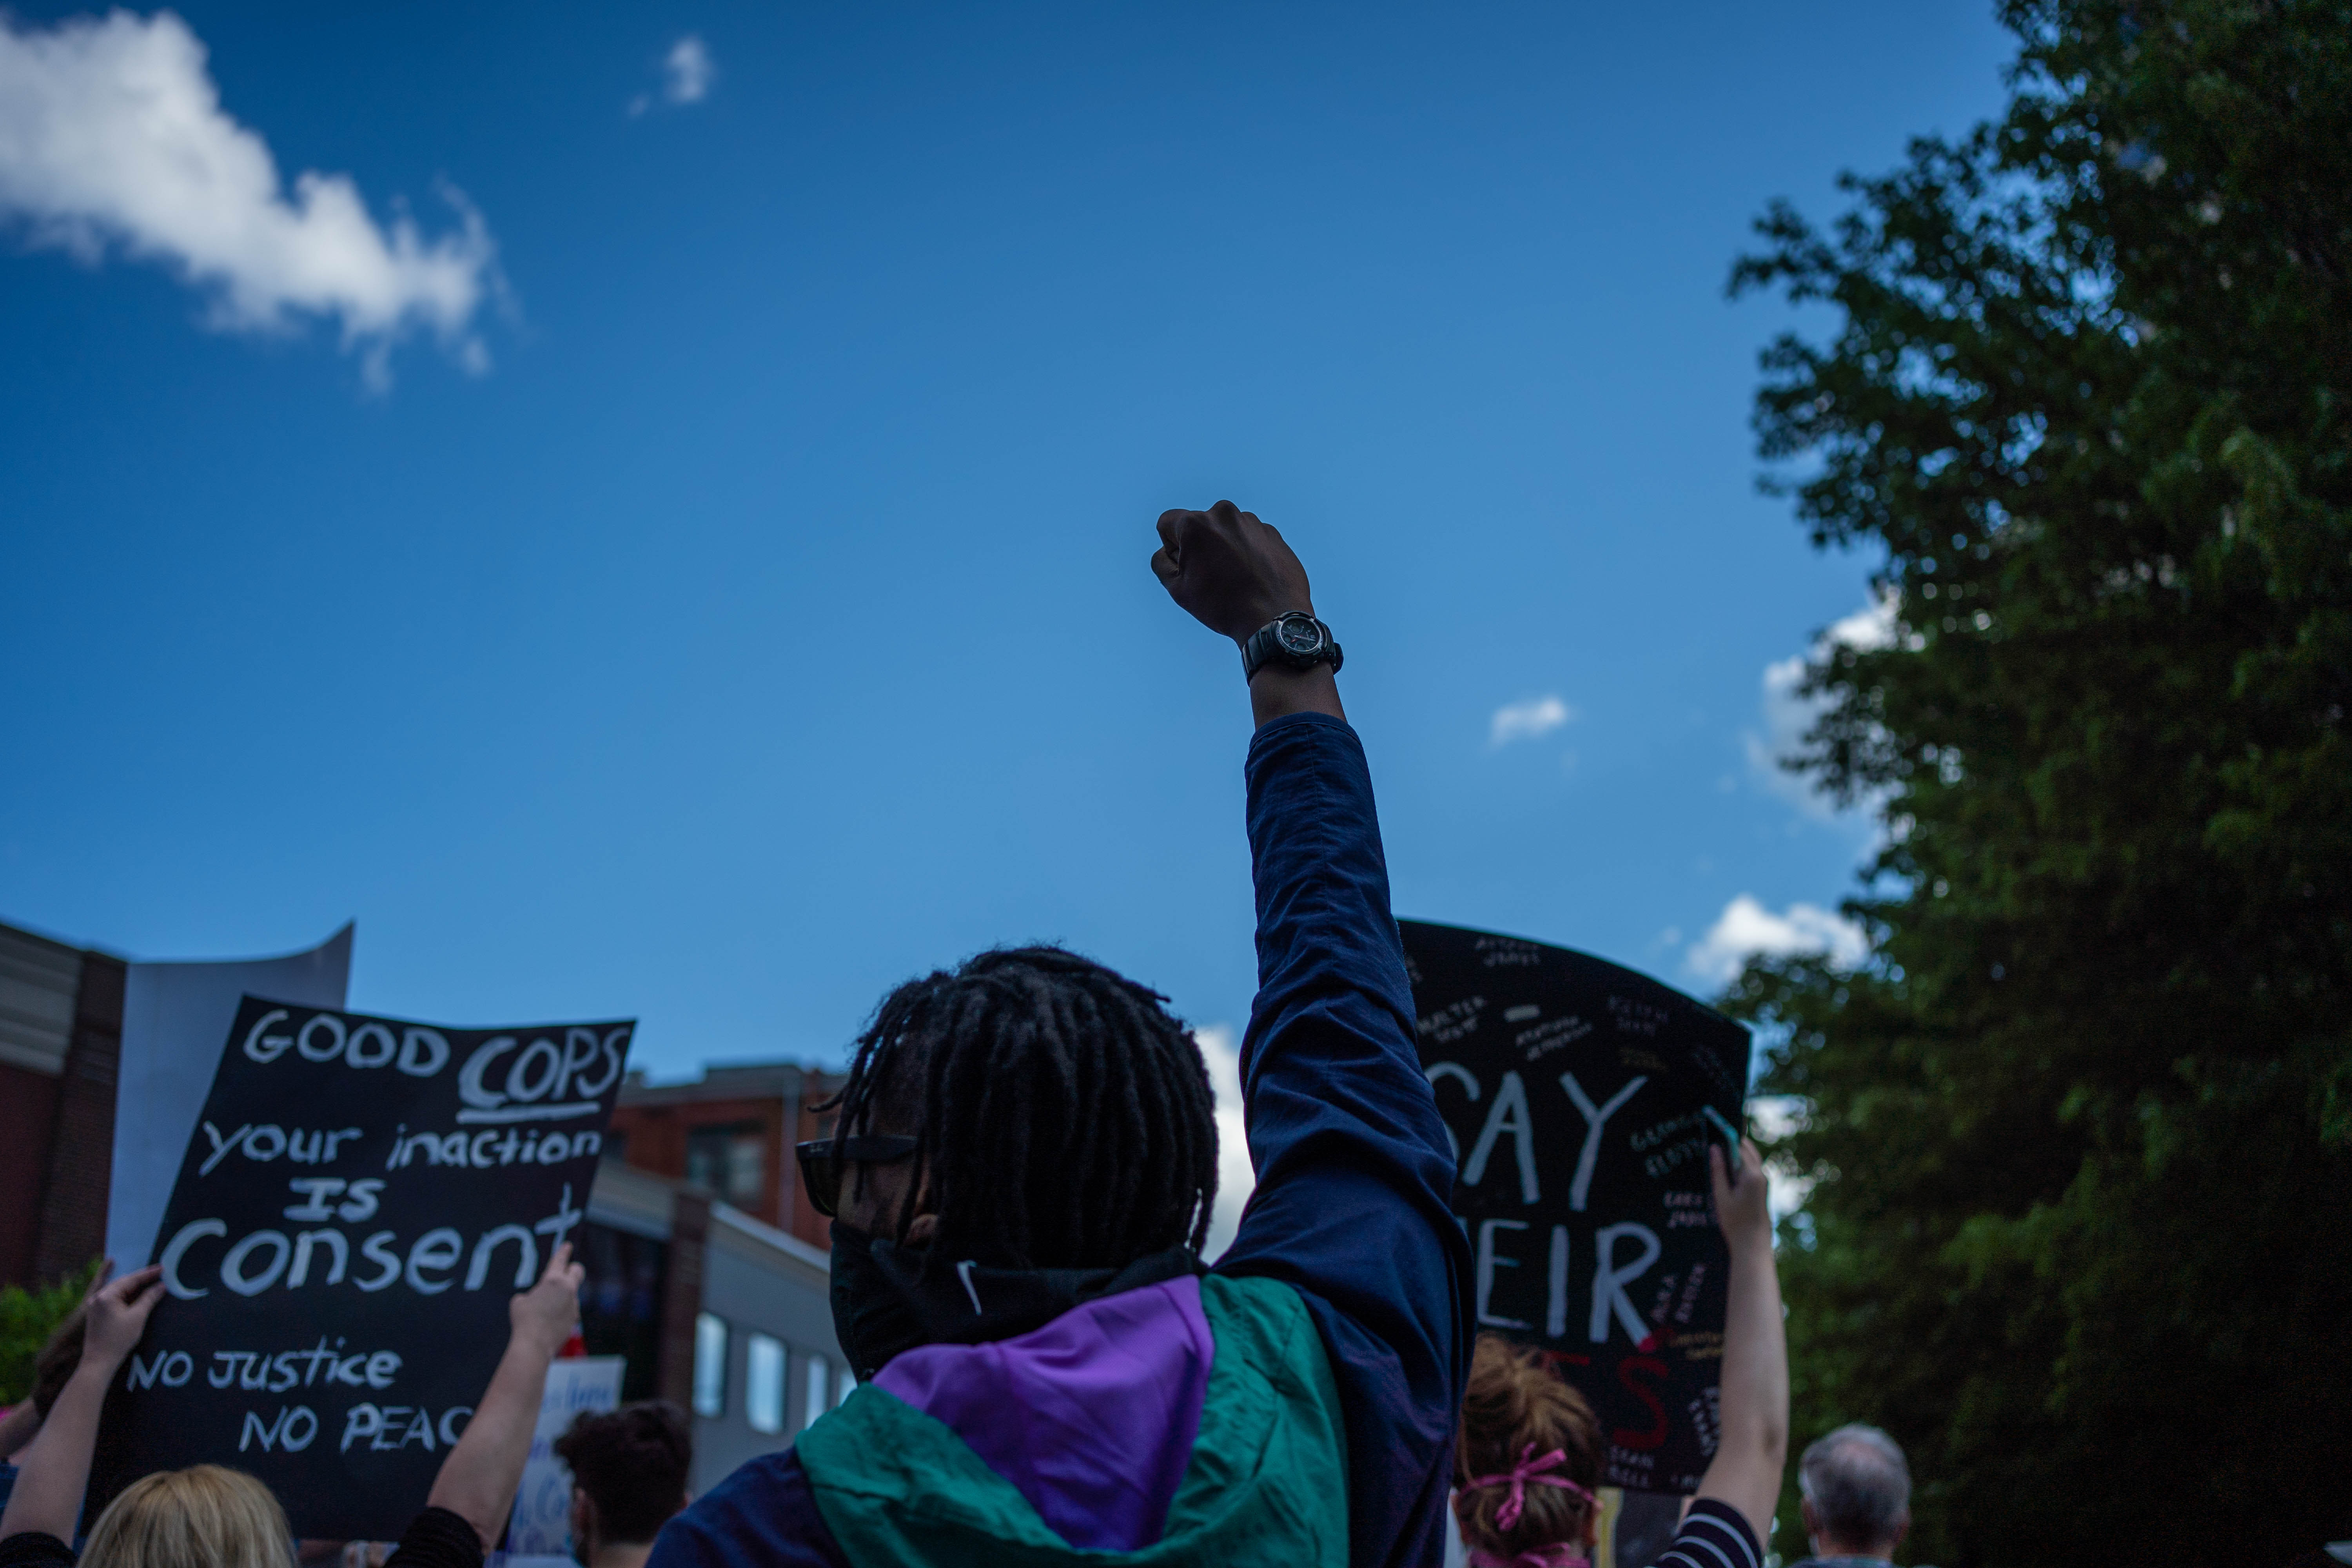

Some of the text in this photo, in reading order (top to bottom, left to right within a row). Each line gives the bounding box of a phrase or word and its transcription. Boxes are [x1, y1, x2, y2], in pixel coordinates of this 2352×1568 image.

[245, 1009, 630, 1109] GOOD COPS
[199, 1120, 601, 1176] your inaction
[284, 1178, 385, 1223] IS
[159, 1181, 582, 1300] Consent
[127, 1350, 194, 1392] NO
[239, 1405, 318, 1452] NO
[339, 1402, 473, 1454] PEAC
